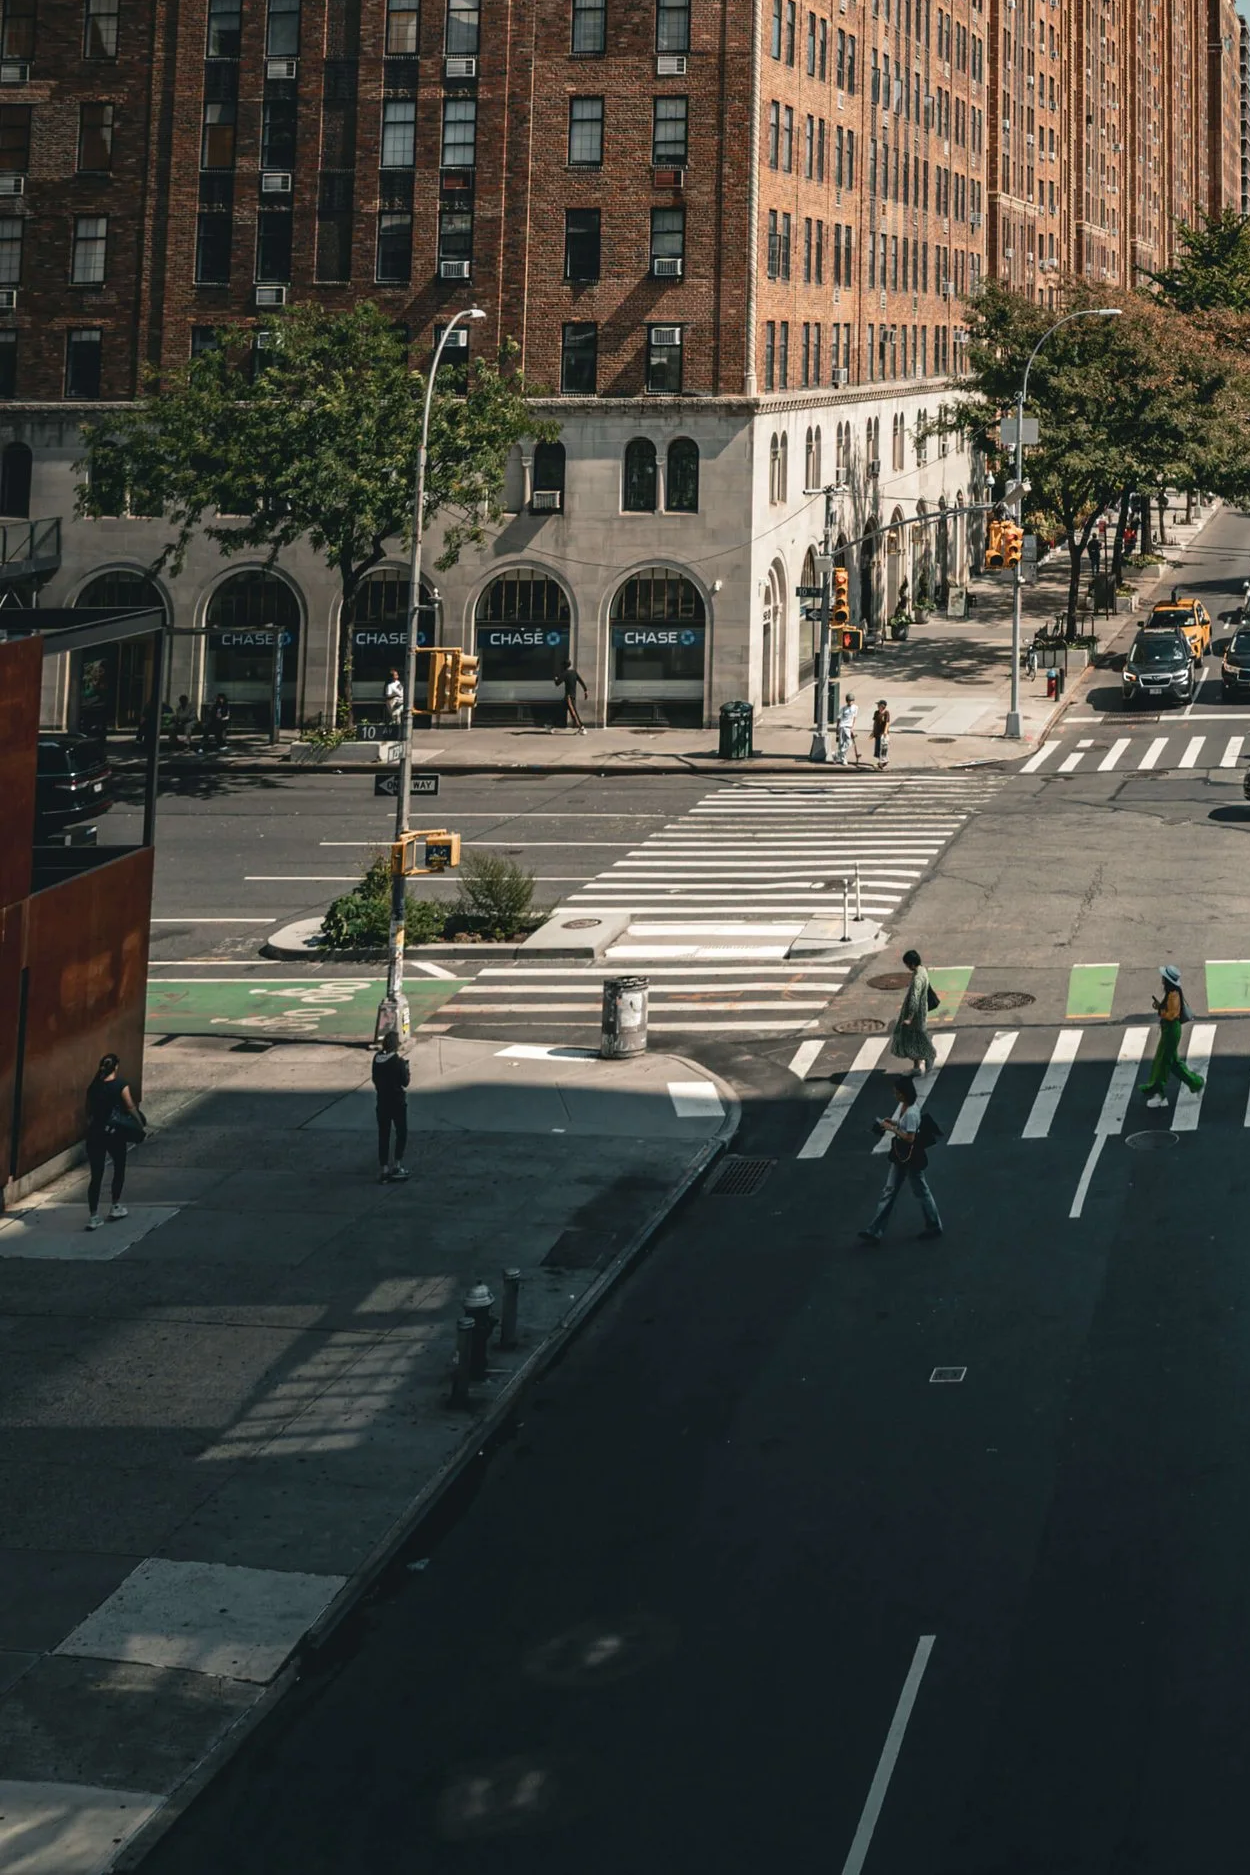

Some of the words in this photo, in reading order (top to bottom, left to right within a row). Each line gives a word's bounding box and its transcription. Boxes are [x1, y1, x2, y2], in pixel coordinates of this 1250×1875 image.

[221, 633, 273, 645] CHASE
[356, 632, 408, 645] CHASE
[490, 633, 543, 645] CHASE
[624, 632, 678, 644] CHASE
[362, 726, 376, 739] 10
[413, 781, 432, 789] WAY
